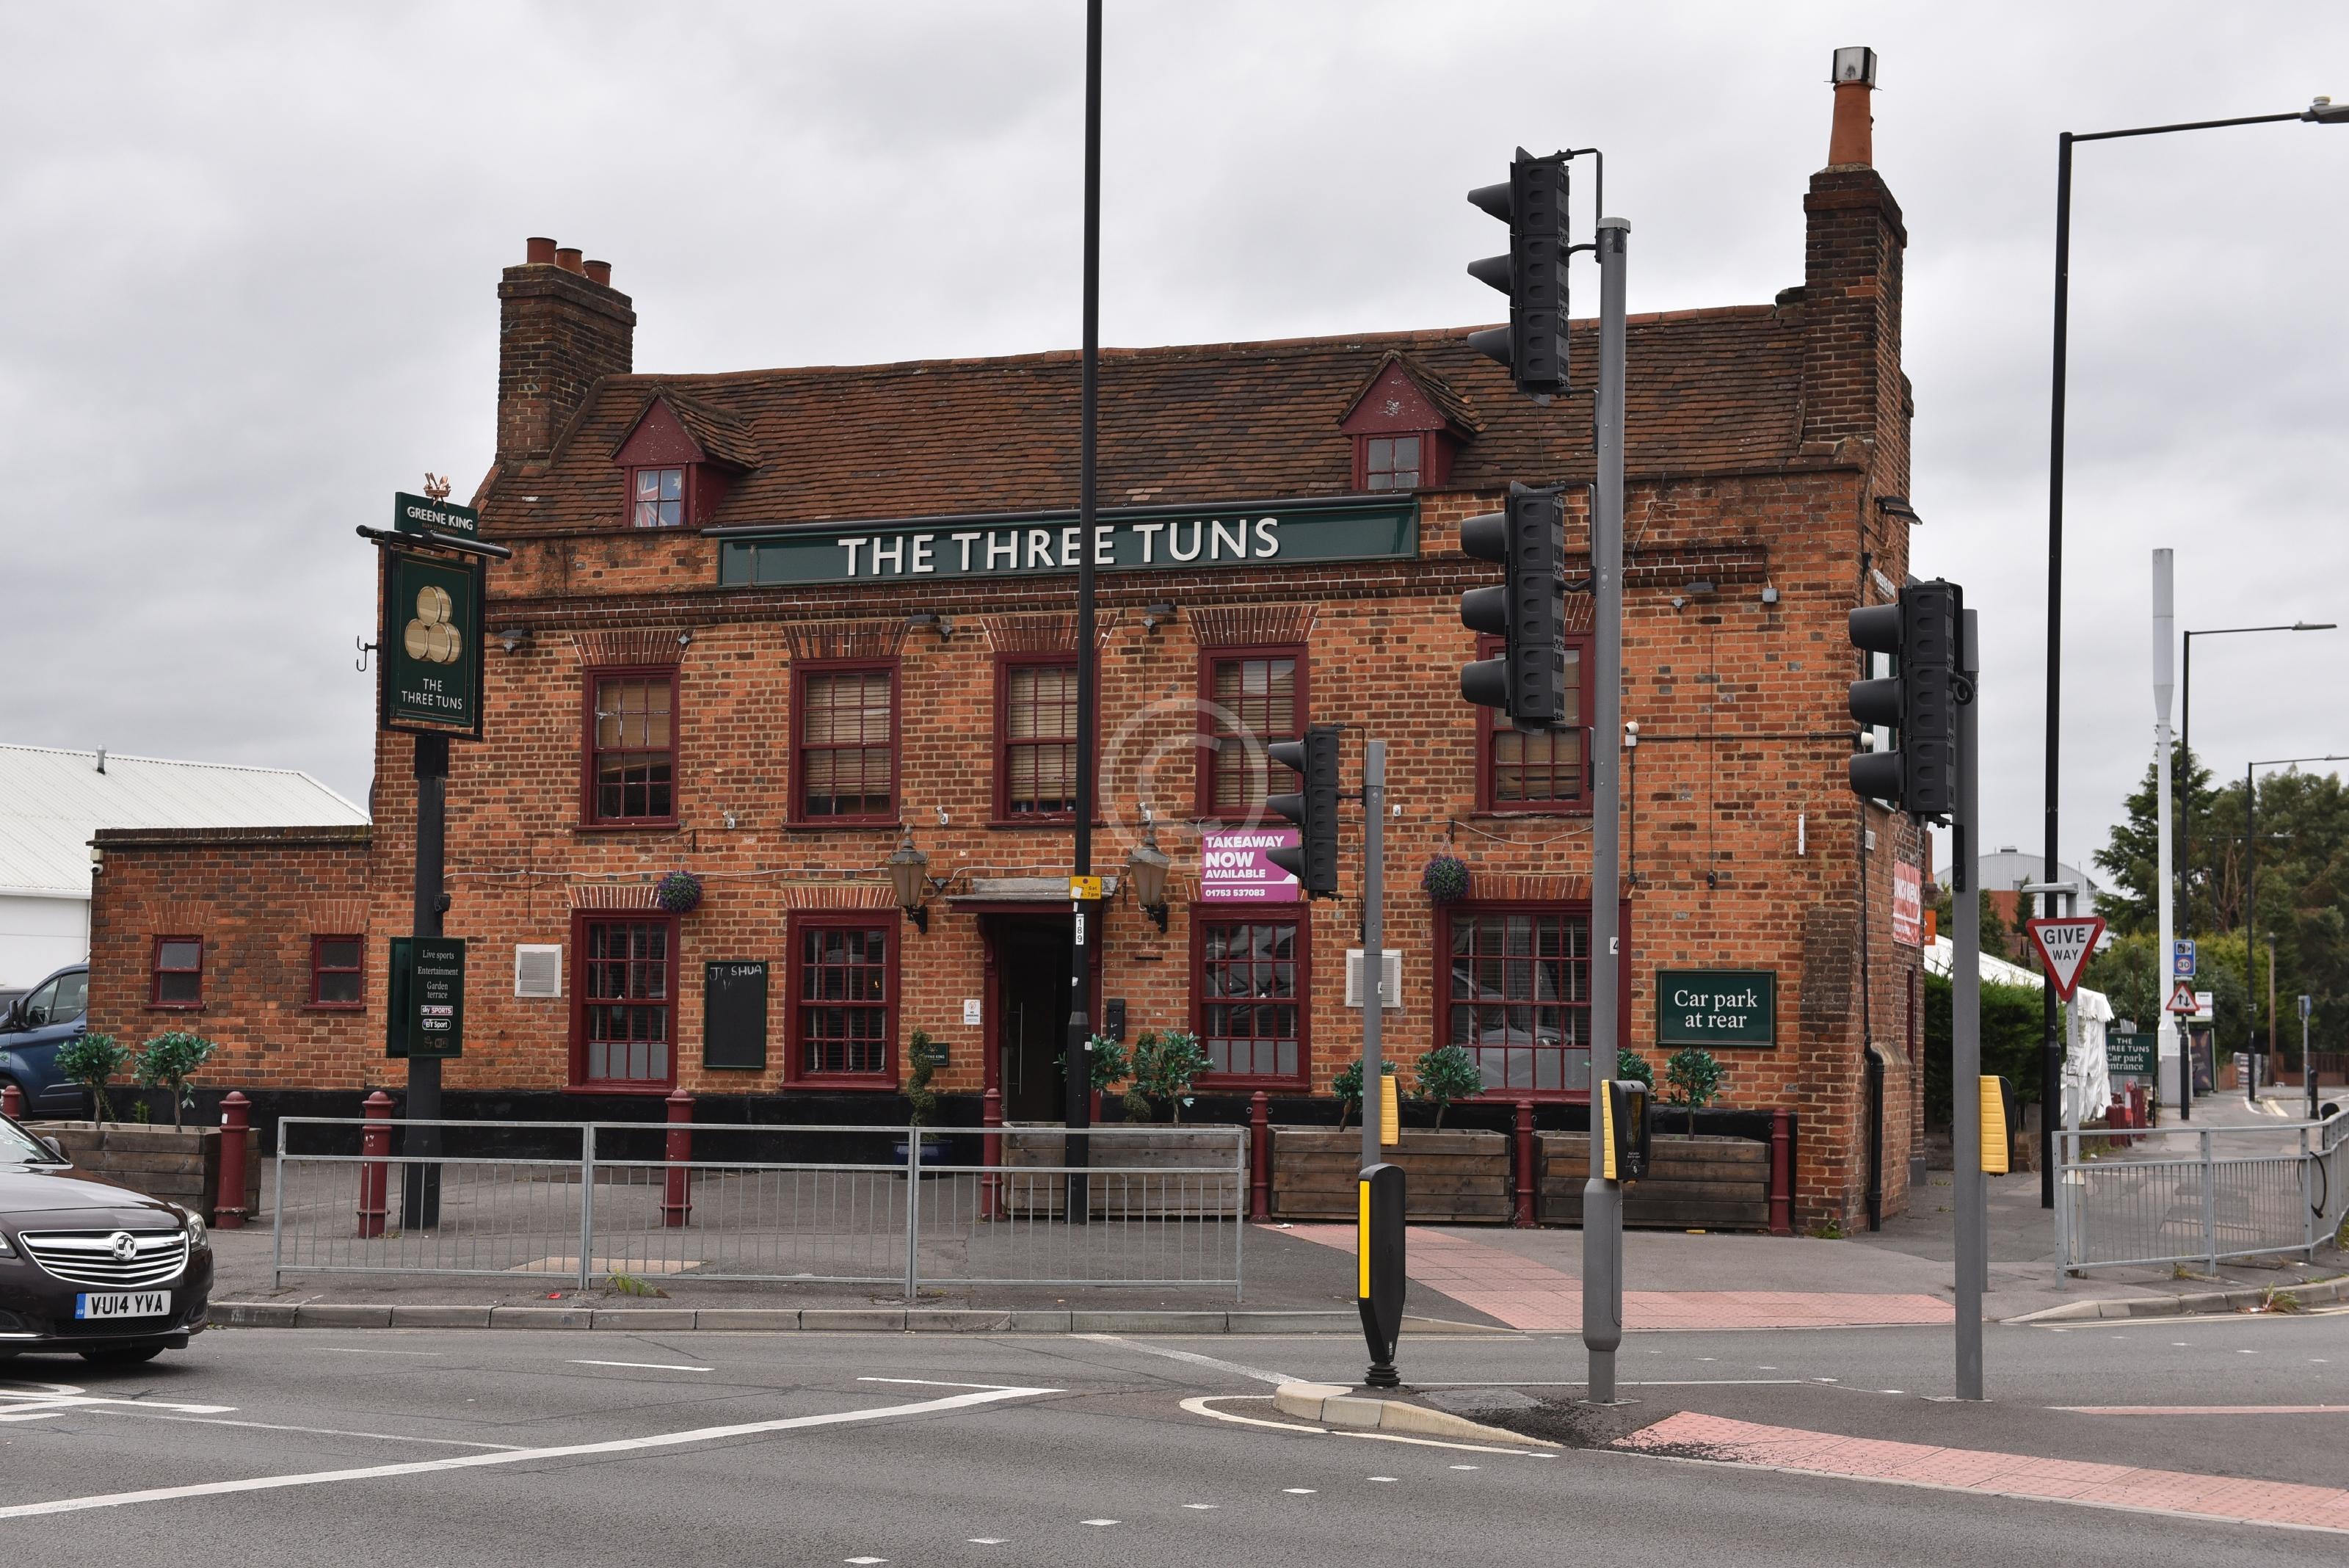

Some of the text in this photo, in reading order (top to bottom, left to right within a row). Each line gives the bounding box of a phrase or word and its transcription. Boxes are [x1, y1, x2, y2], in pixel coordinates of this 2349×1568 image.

[407, 507, 473, 531] GREENE KING
[838, 518, 1279, 576] THE THREE TUNS
[423, 678, 443, 692] THE
[402, 690, 462, 710] THREE TUNS
[1205, 835, 1285, 848] TAKEAWAY
[1205, 852, 1255, 868] NOW
[1205, 869, 1266, 879] AVAILABLE
[1205, 889, 1266, 897] 01753 537083
[2044, 928, 2085, 944] GIVE
[422, 949, 454, 961] Live sports
[2052, 949, 2079, 960] WAY
[418, 966, 458, 976] Entertainment
[426, 981, 449, 990] Garden
[1674, 988, 1757, 1012] Car park
[422, 1006, 430, 1015] sky
[434, 1021, 448, 1029] Sport
[1685, 1012, 1747, 1028] at rear
[2107, 1053, 2143, 1064] Car park
[92, 1293, 163, 1315] VU14 YVA
